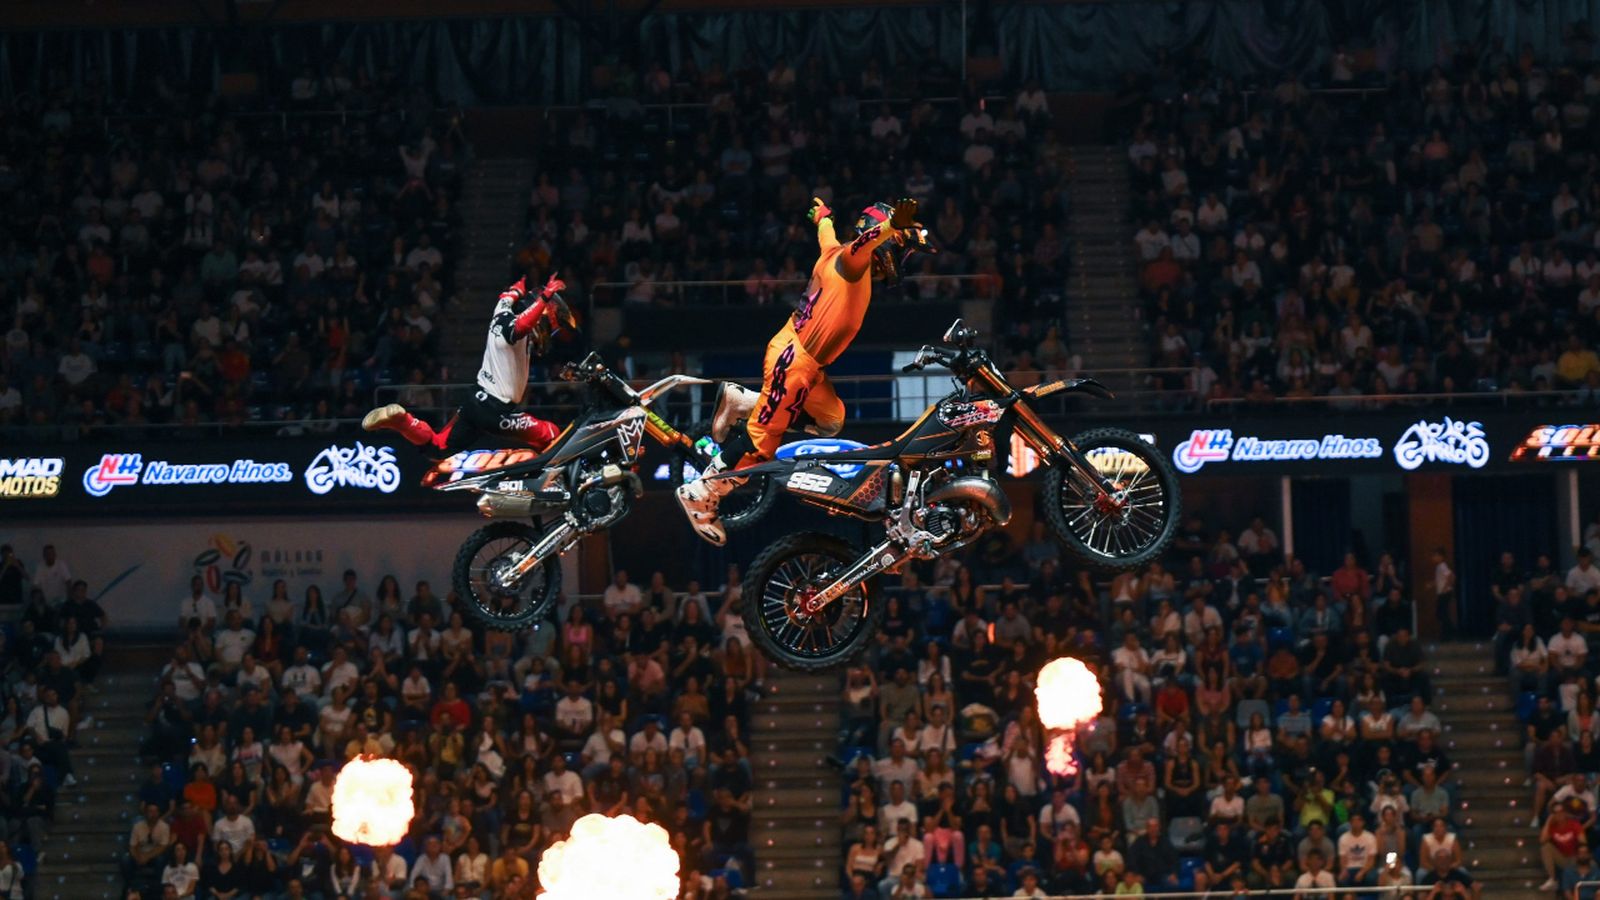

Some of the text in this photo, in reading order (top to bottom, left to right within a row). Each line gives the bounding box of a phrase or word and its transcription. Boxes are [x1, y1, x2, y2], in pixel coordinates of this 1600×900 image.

[1232, 437, 1319, 460] Navarro
[1319, 435, 1382, 458] Hnos.
[1526, 425, 1600, 448] SOL
[0, 458, 64, 477] MAD
[96, 454, 143, 485] NH
[143, 461, 229, 484] Navarro
[229, 459, 292, 482] Hnos.
[0, 476, 59, 495] MOTOS
[787, 472, 833, 493] 952
